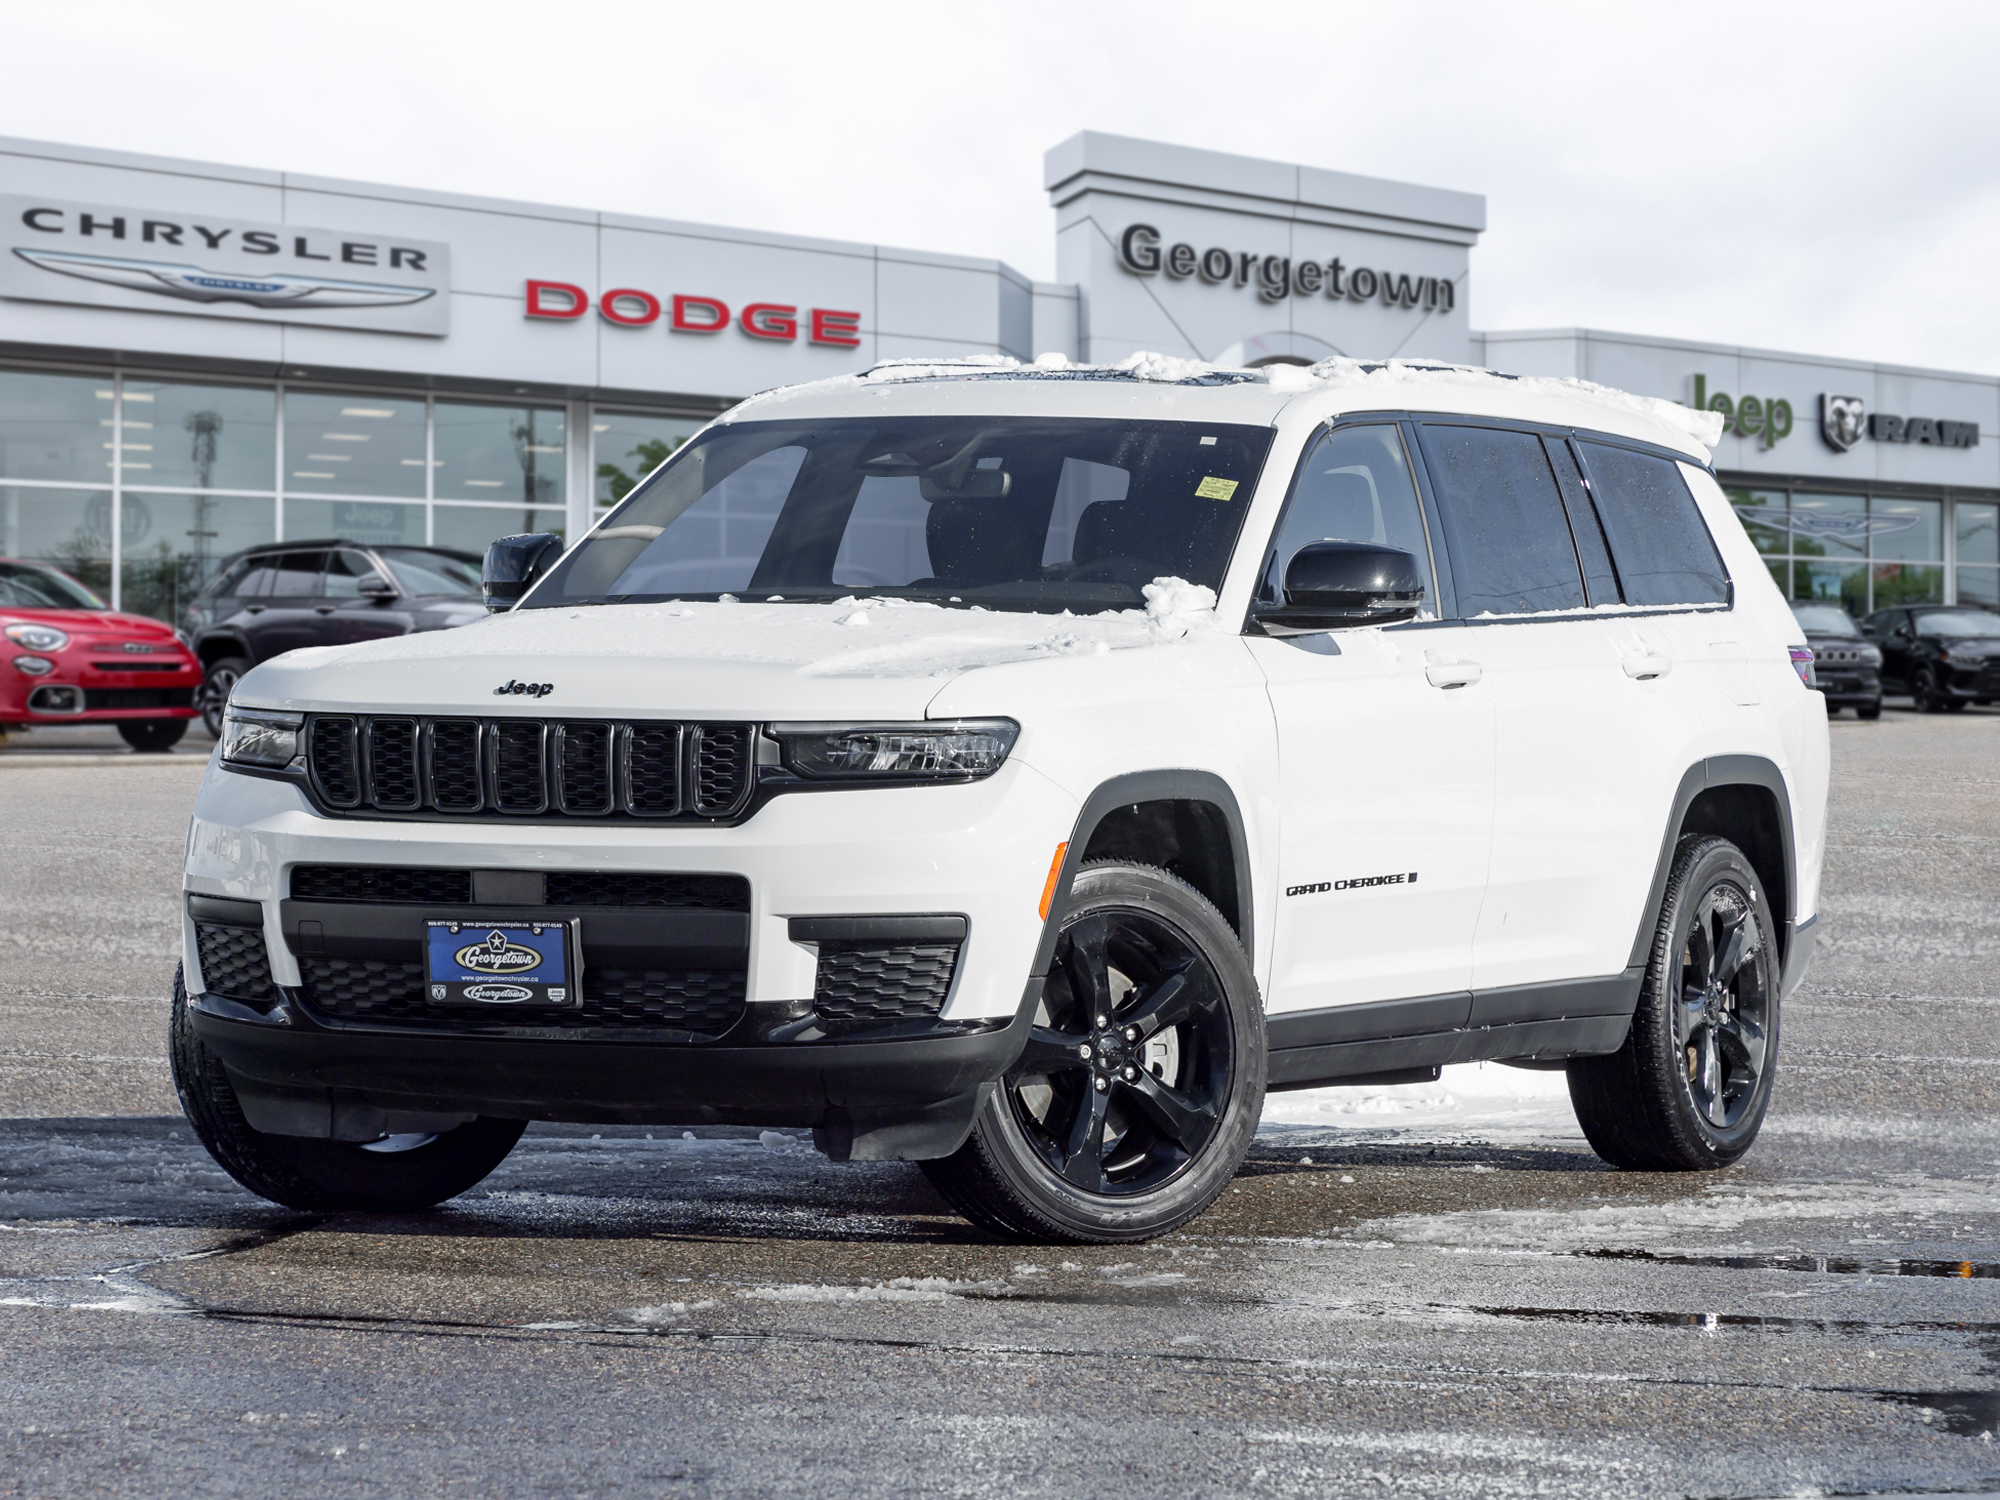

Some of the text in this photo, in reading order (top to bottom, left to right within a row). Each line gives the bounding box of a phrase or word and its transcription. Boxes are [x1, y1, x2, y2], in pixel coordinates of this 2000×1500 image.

[22, 207, 428, 272] CHRYSLER
[1118, 222, 1455, 311] Georgetown
[524, 279, 861, 348] DODGE
[1868, 412, 1979, 448] RAM
[499, 679, 554, 698] Jeep
[1286, 881, 1332, 897] GRAND
[1334, 873, 1405, 891] CHEROKEE
[464, 945, 534, 969] Georgetown
[461, 974, 538, 983] www.georgetownchrysler.ca
[469, 984, 527, 1000] Georgetown
